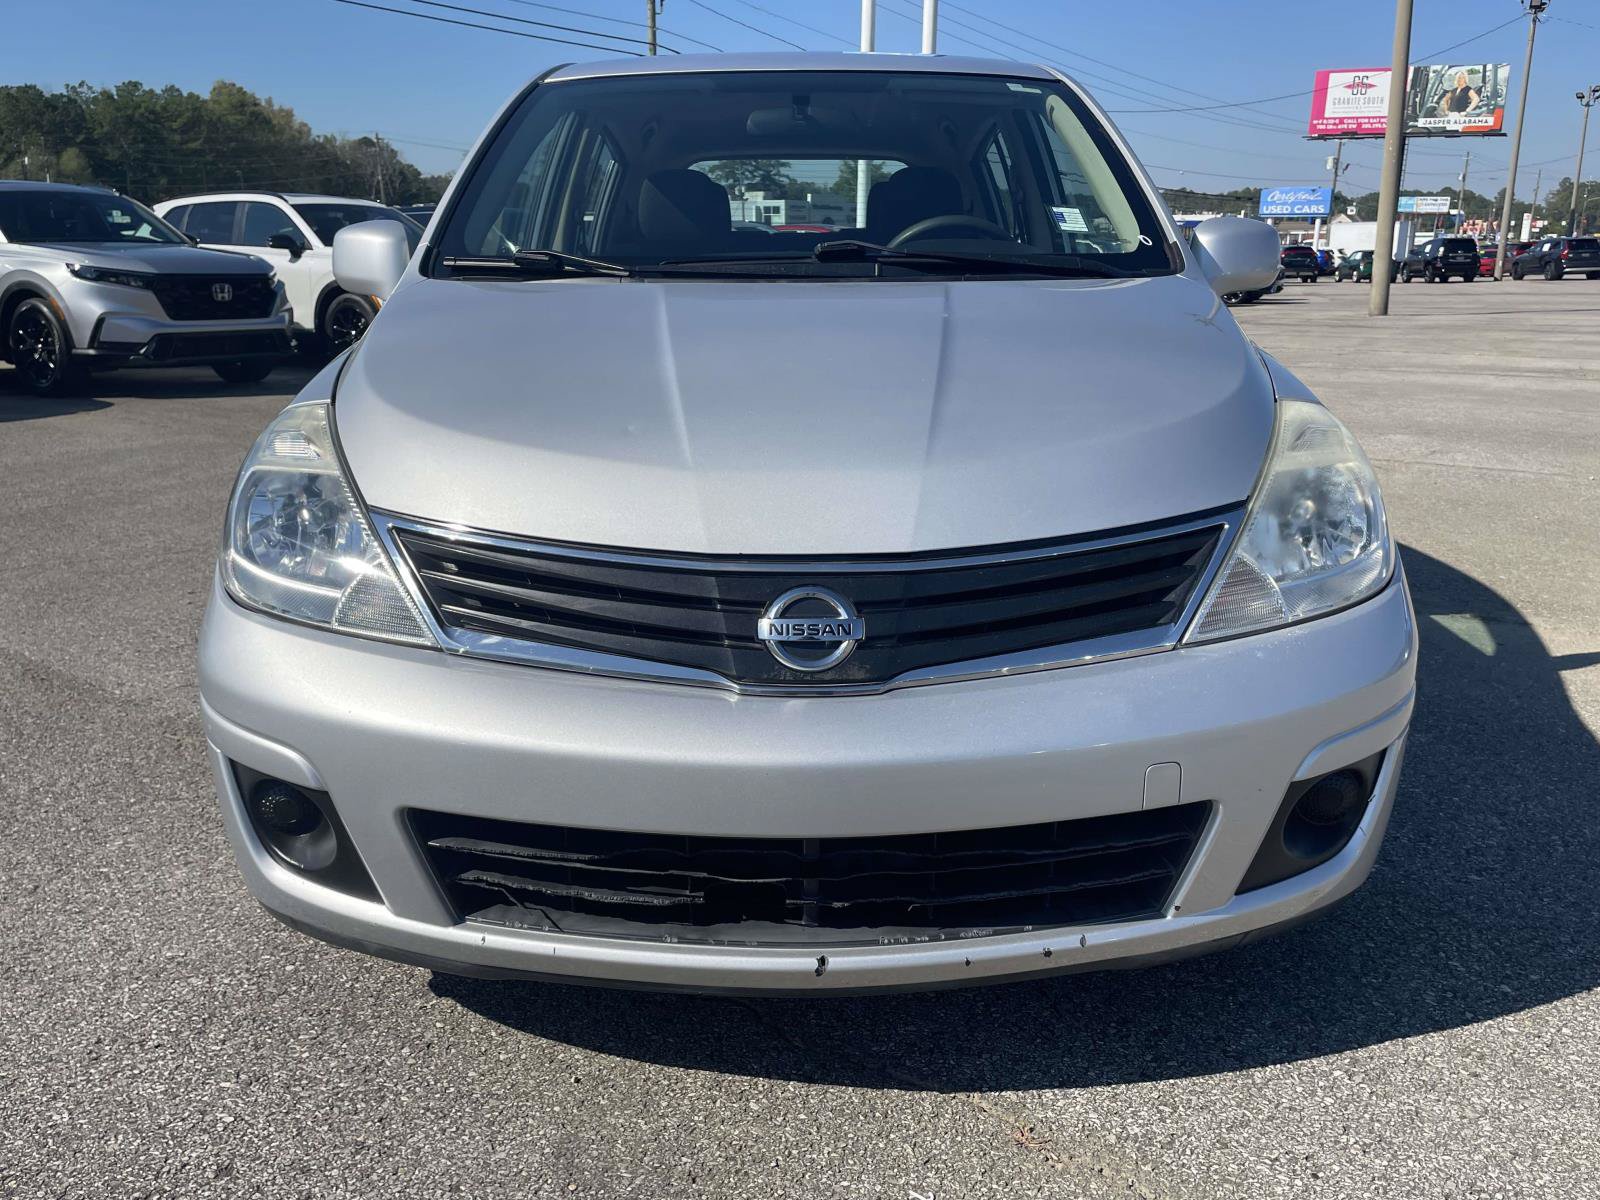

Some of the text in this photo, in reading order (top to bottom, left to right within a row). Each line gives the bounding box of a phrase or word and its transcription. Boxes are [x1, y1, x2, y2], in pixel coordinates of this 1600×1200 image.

[1332, 96, 1385, 106] GRANITE SOUTH
[1267, 190, 1323, 204] Certified
[1263, 204, 1325, 213] USED CARS
[769, 623, 852, 636] NISSAN
